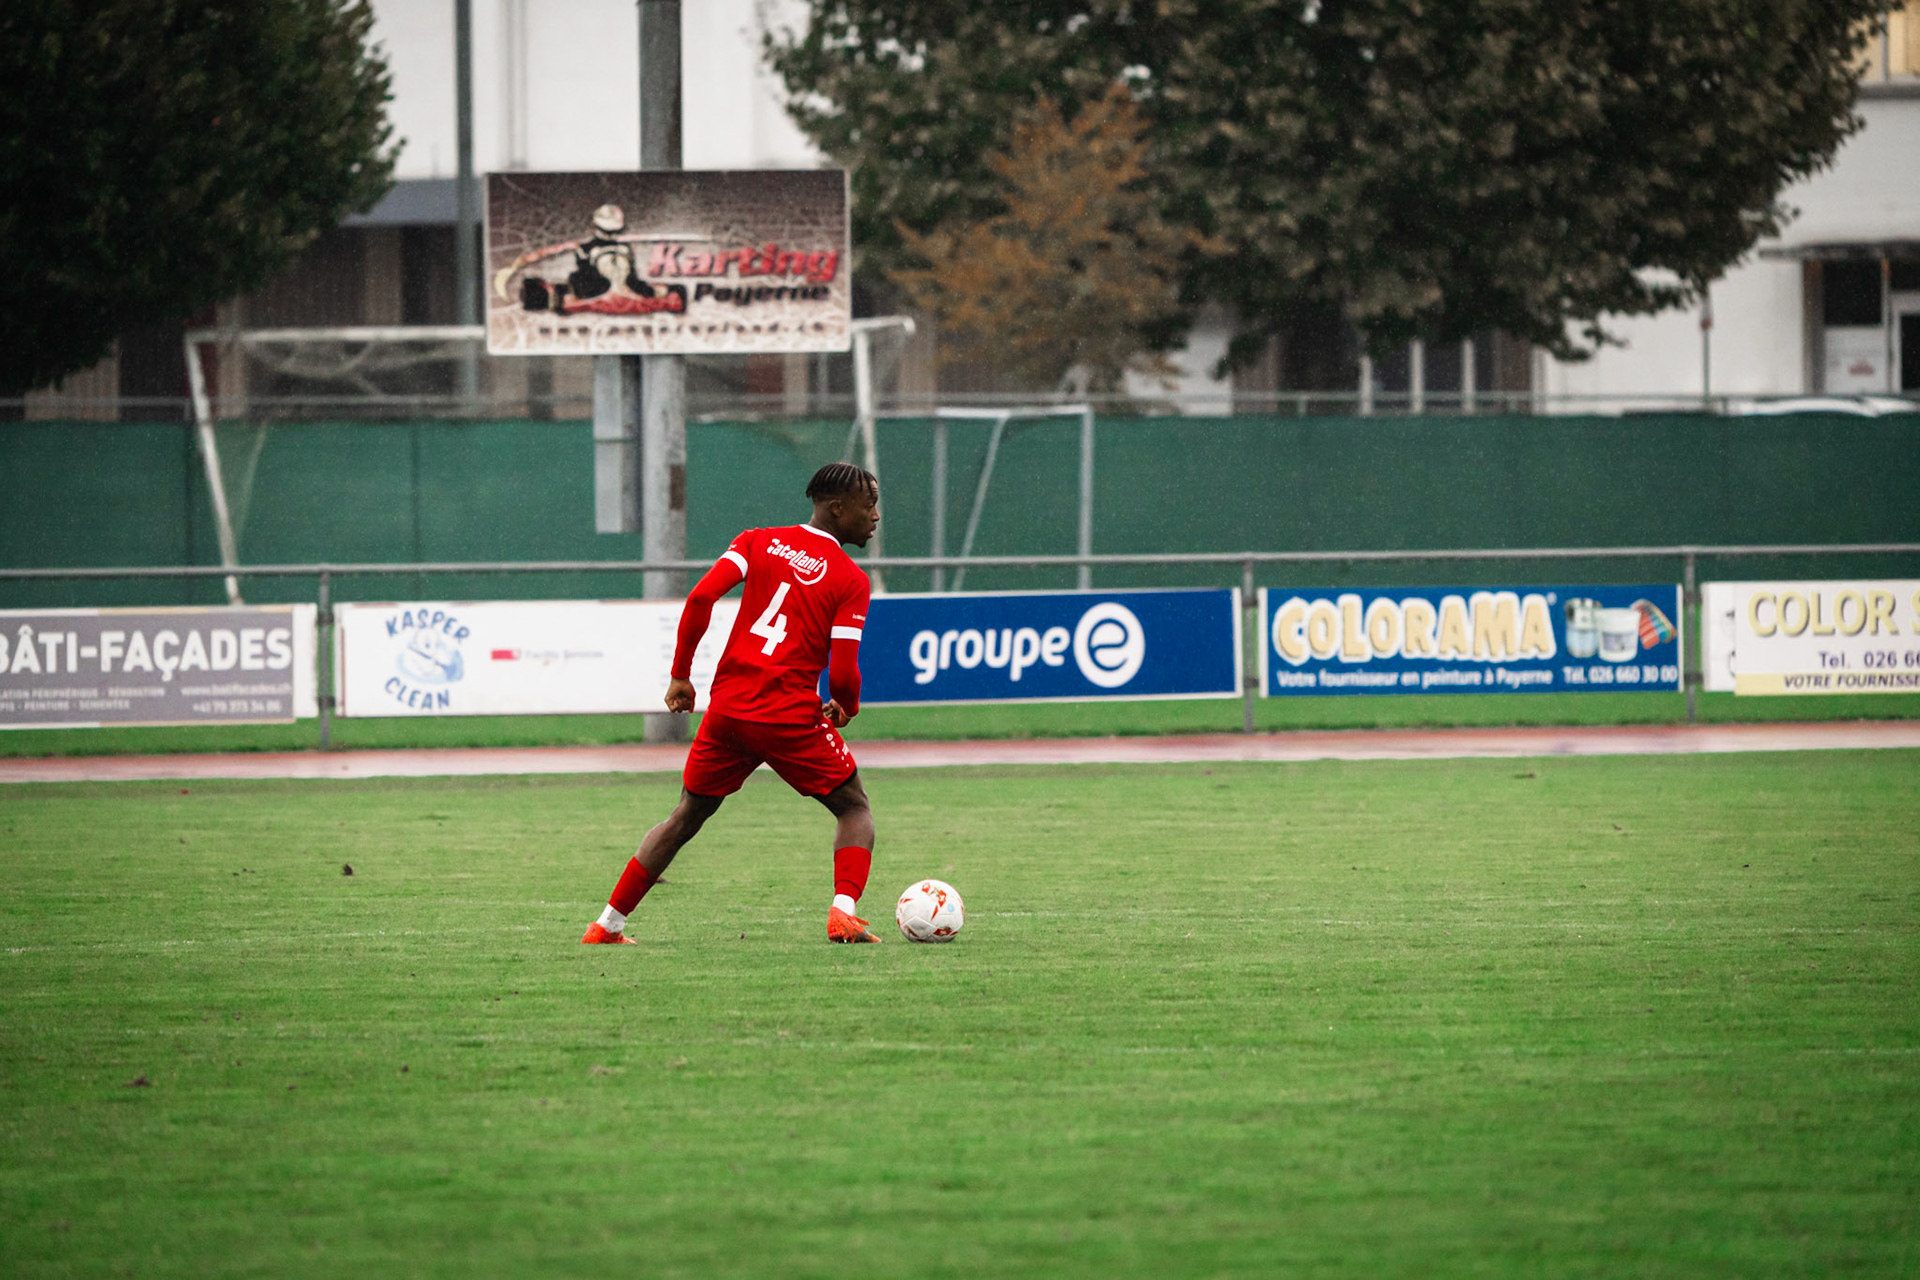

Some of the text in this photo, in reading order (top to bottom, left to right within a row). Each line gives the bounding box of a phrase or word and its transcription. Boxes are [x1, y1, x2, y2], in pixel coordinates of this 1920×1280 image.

[650, 244, 838, 281] Karting
[694, 283, 830, 306] Payerne
[385, 608, 470, 644] KASPER
[749, 581, 792, 656] 4
[1273, 591, 1557, 665] COLORAMA
[1748, 588, 1899, 637] COLOR
[909, 626, 1071, 685] groupe
[1864, 651, 1897, 668] 026
[1277, 667, 1553, 690] Votre fournisseur en peinture à Payerne
[1588, 665, 1614, 683] 026
[1660, 664, 1678, 682] 00
[1785, 674, 1832, 688] VOTRE
[384, 677, 449, 710] CLEAN
